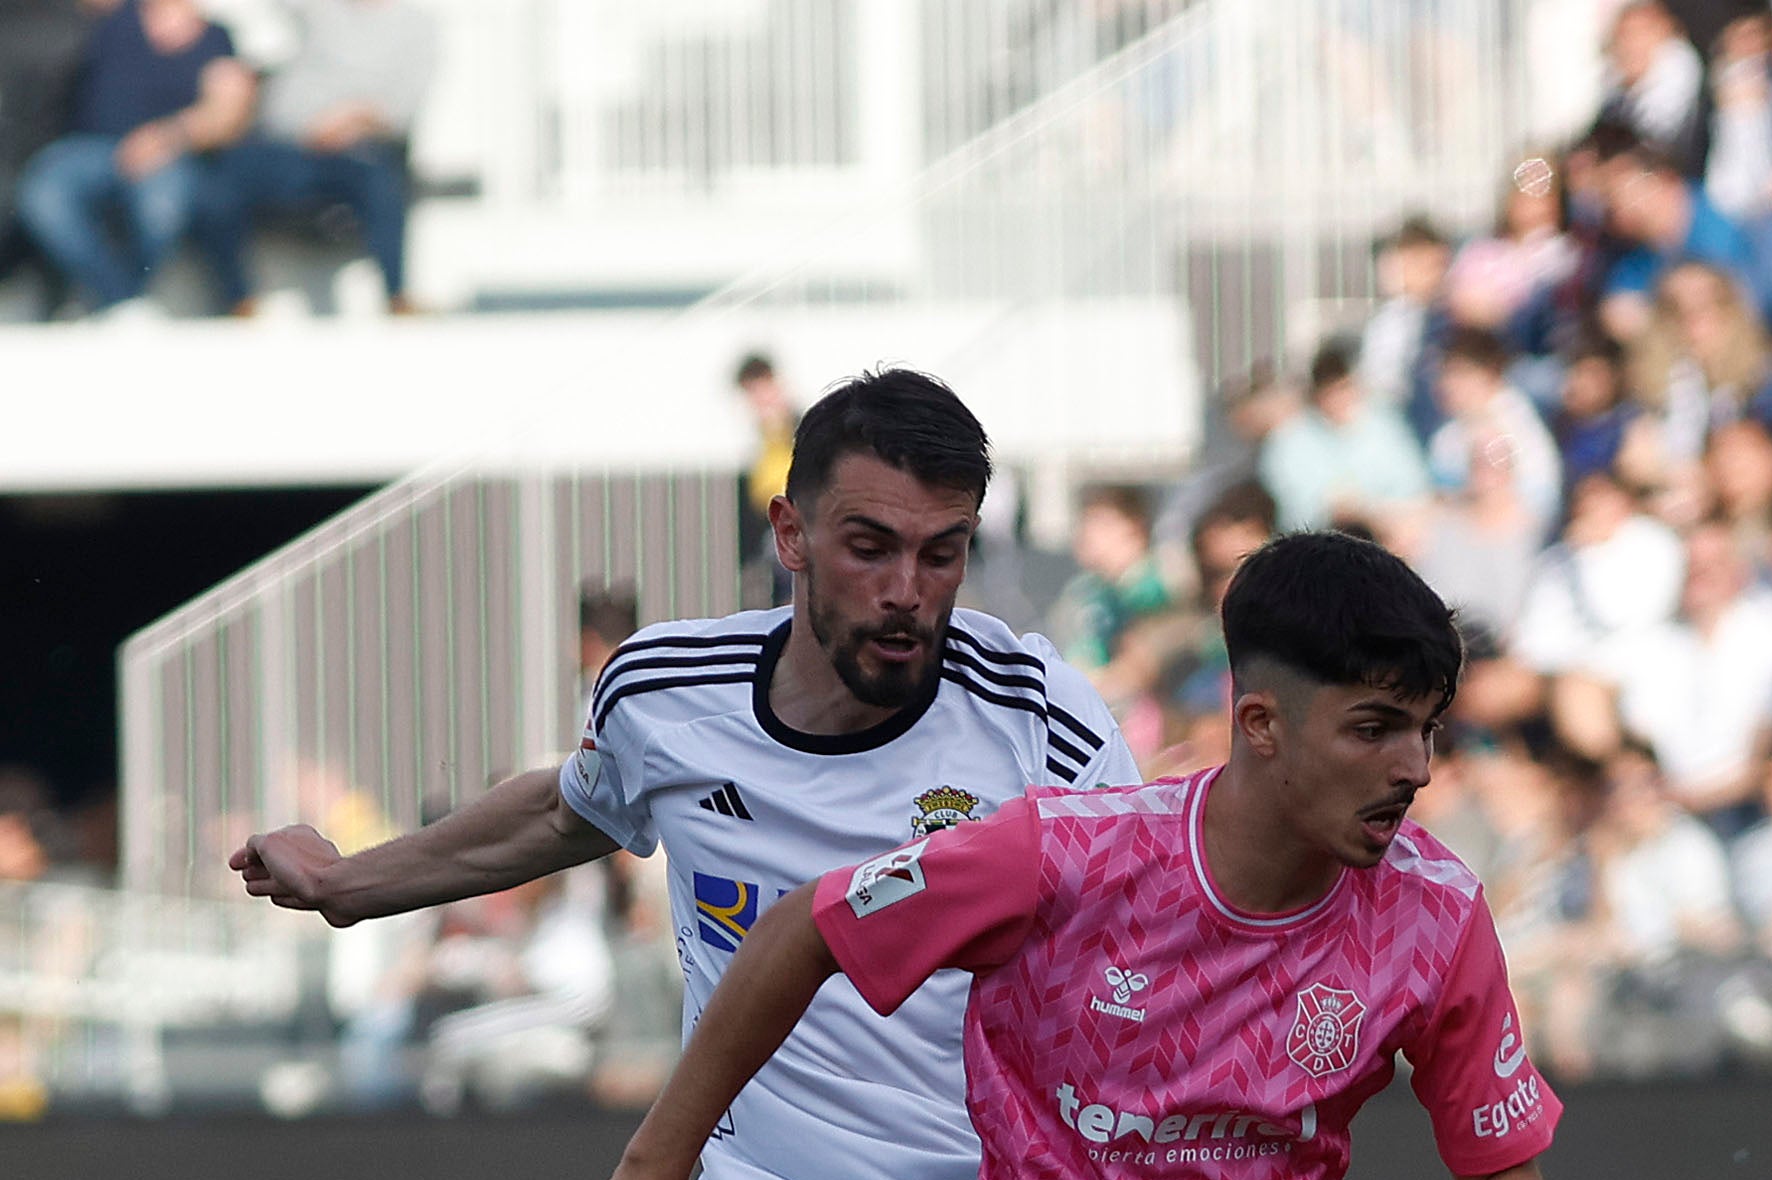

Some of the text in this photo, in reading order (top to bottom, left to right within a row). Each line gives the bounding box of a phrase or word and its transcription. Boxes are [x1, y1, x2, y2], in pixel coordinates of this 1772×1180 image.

[933, 810, 958, 819] CLUB
[1090, 995, 1146, 1022] hummel
[1166, 1142, 1279, 1163] emociones
